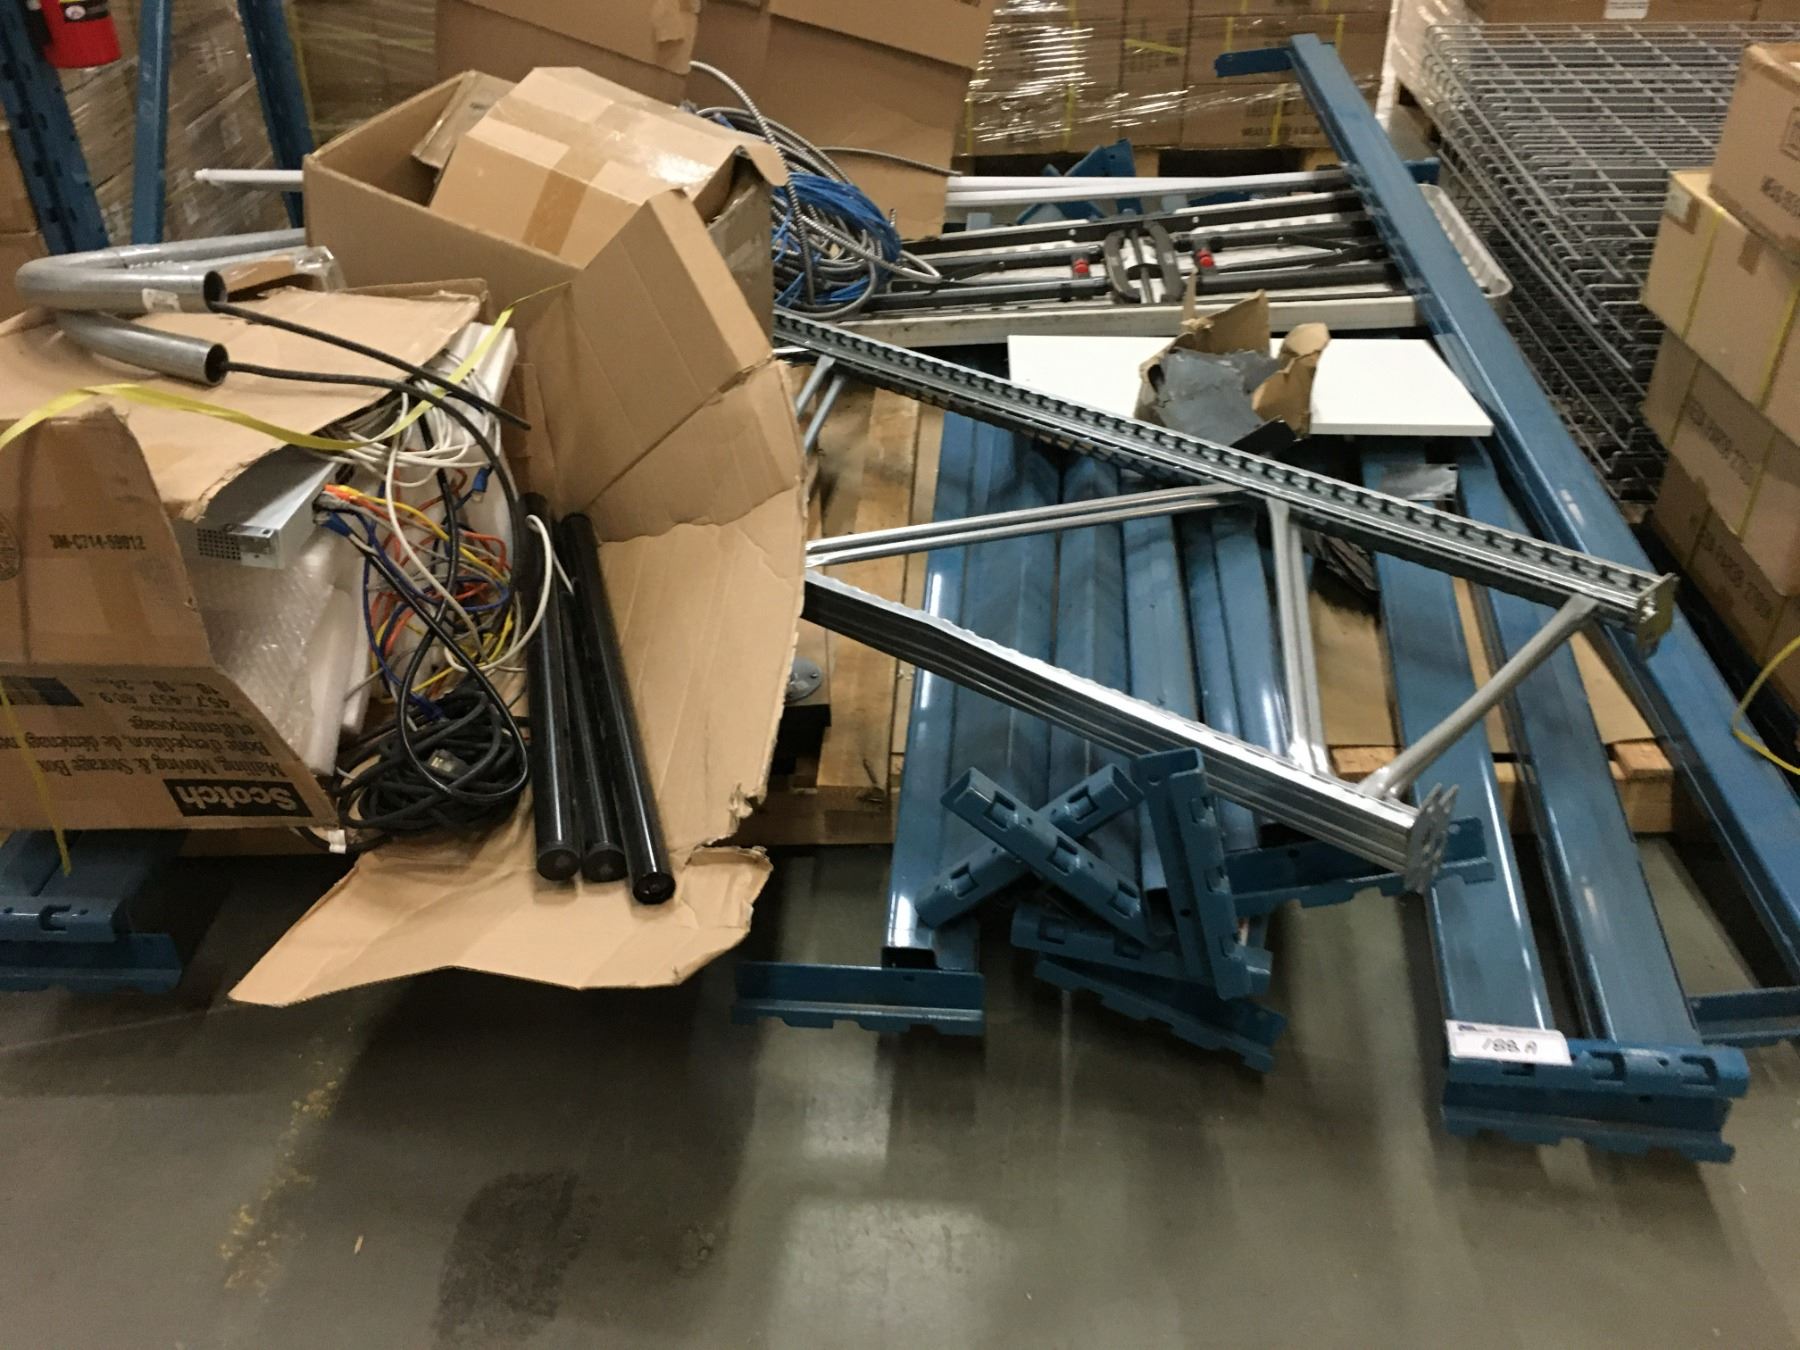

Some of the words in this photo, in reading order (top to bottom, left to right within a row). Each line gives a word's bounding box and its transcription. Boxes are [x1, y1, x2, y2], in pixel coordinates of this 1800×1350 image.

[101, 735, 122, 752] de
[37, 759, 73, 776] Box
[73, 756, 134, 775] Storage
[133, 757, 149, 774] &
[151, 754, 217, 774] Moving
[175, 786, 298, 811] Scotch
